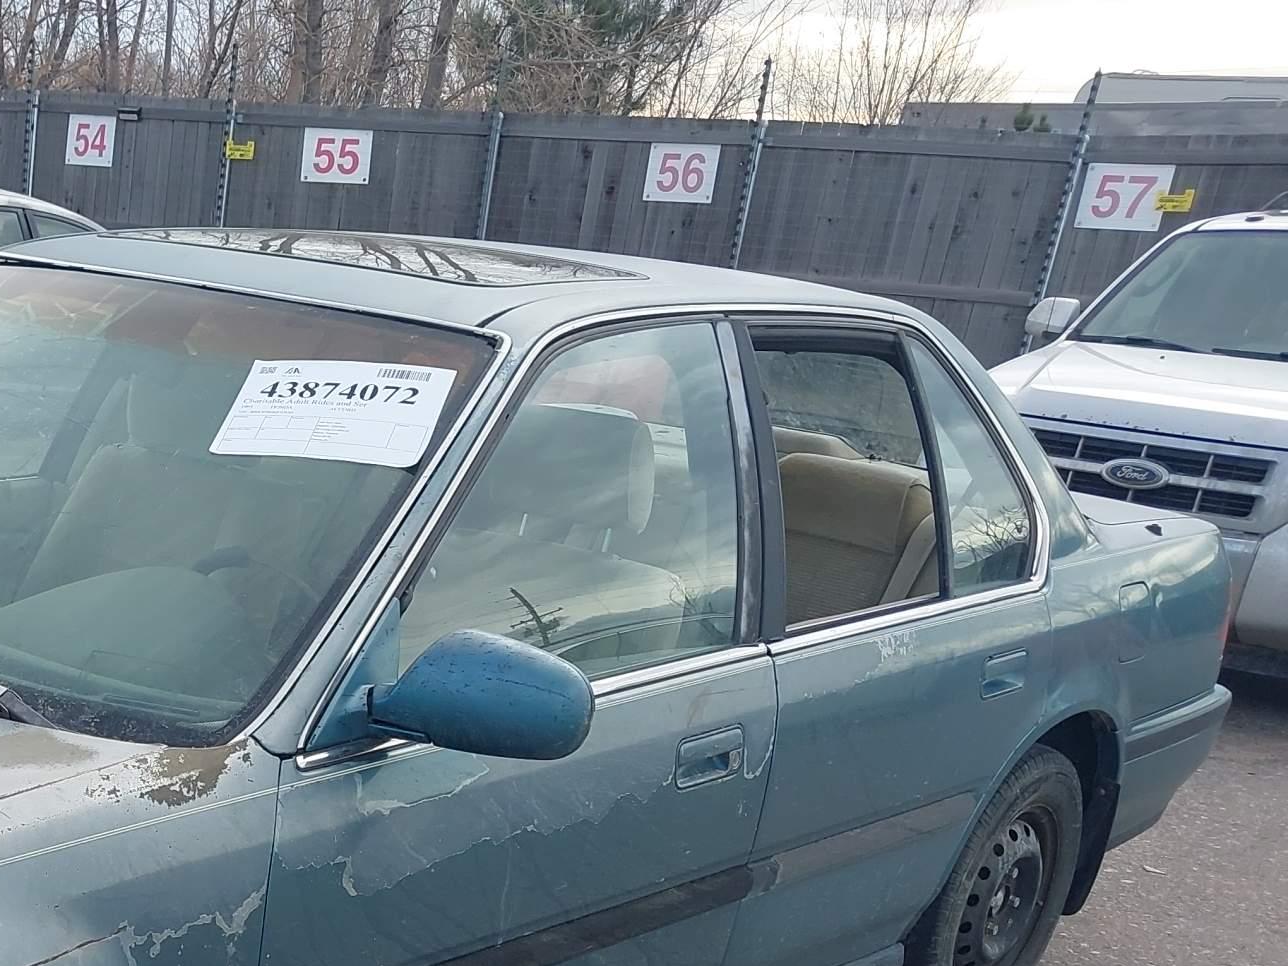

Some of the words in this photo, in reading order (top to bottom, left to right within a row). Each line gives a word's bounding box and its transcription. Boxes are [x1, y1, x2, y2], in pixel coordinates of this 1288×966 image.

[73, 123, 107, 157] 54
[312, 137, 361, 174] 55
[656, 152, 706, 193] 56
[1091, 174, 1159, 219] 57
[260, 381, 420, 405] 43874072
[1116, 465, 1149, 480] Ford
